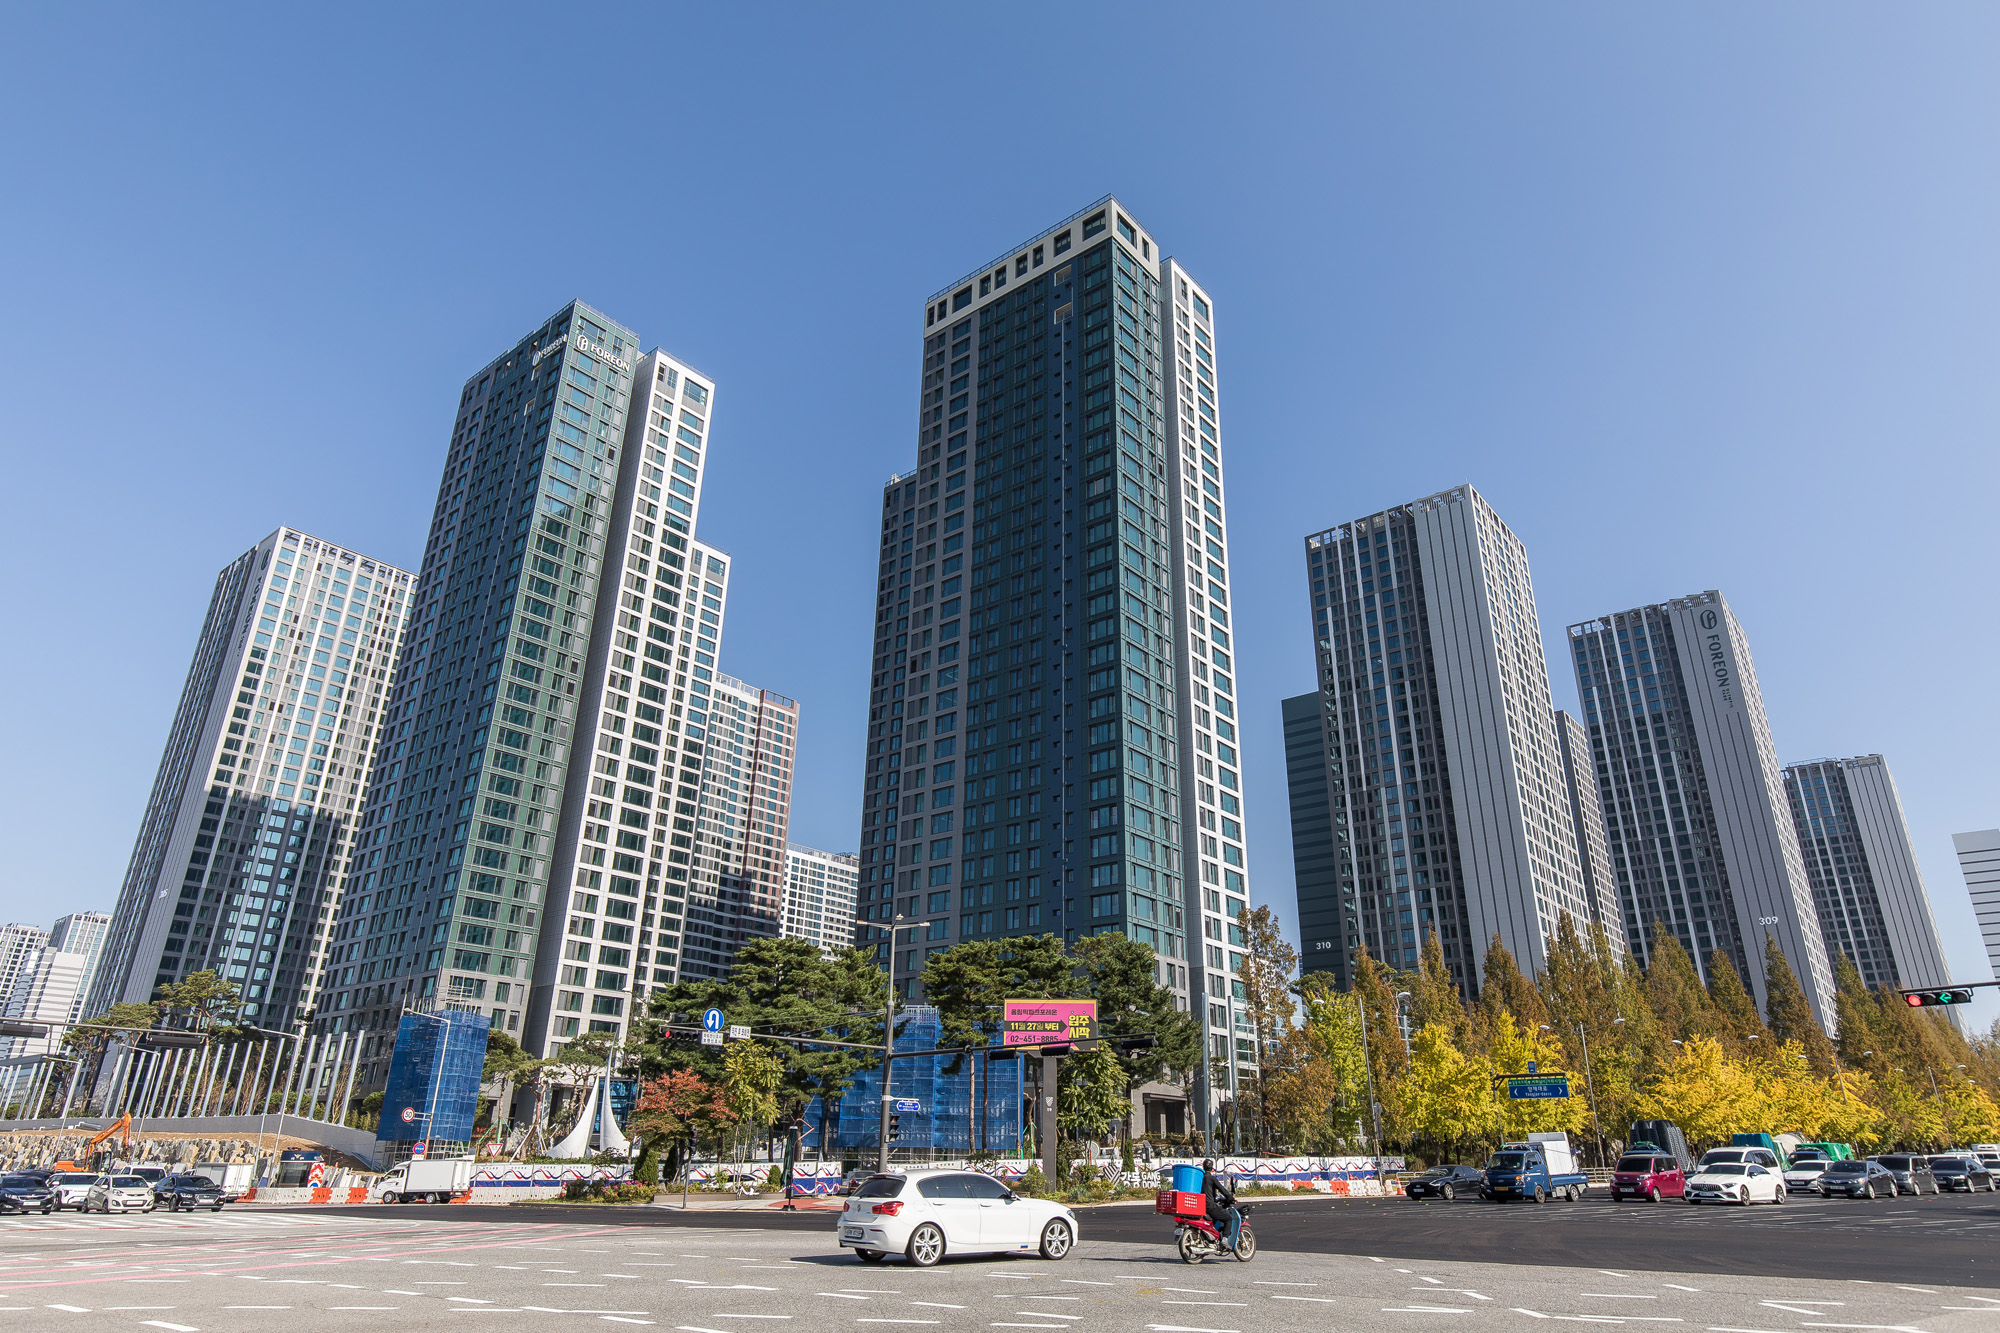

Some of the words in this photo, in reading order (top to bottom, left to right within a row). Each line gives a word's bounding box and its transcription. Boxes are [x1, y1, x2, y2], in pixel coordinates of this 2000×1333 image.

[590, 343, 630, 372] FOREON
[1707, 634, 1730, 687] FOREON
[1758, 916, 1778, 925] 309
[1316, 941, 1331, 950] 310
[1068, 1015, 1090, 1027] 입주
[1010, 1022, 1026, 1031] 11월
[1027, 1022, 1044, 1031] 27일
[1045, 1022, 1059, 1031] 부터
[1068, 1027, 1090, 1039] 시작
[405, 1110, 412, 1119] 50
[1120, 1171, 1140, 1188] 강동
[1141, 1172, 1160, 1181] GANG
